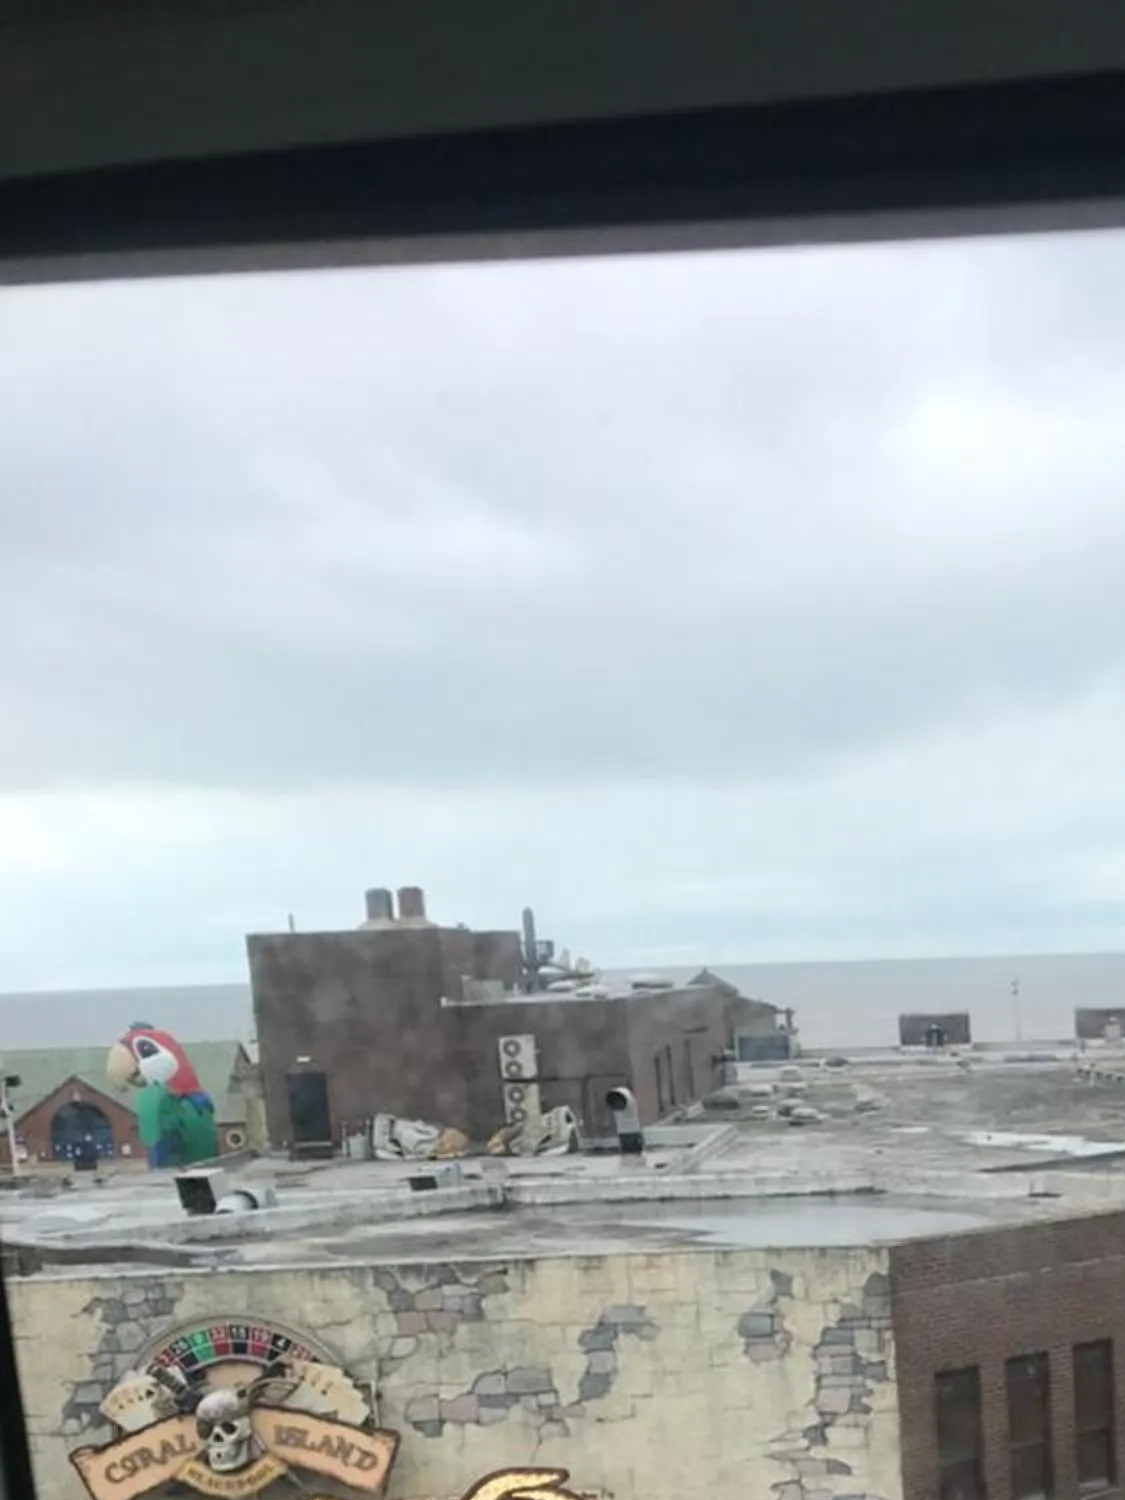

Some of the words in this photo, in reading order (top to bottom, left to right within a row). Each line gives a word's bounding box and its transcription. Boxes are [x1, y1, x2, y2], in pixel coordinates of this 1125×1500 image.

[276, 1337, 287, 1347] 4
[104, 1432, 197, 1484] CORAL
[273, 1424, 378, 1471] ISLAND
